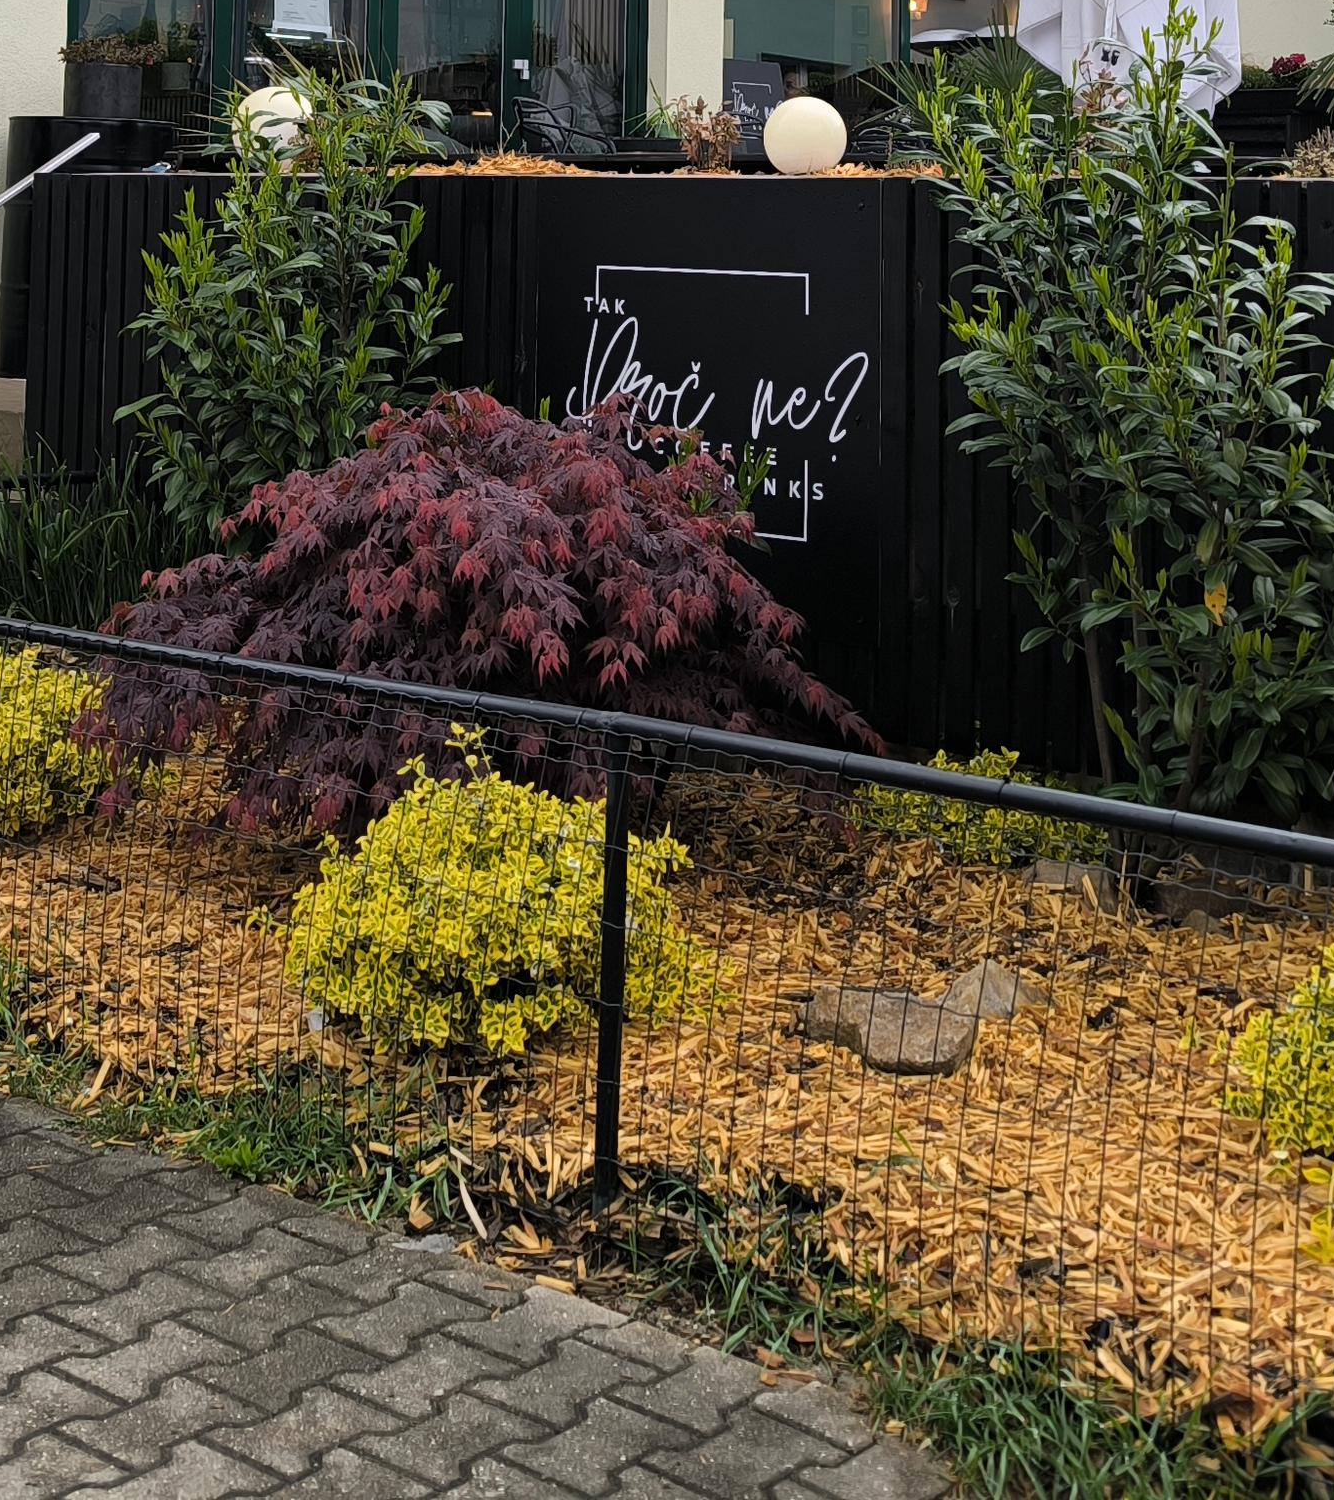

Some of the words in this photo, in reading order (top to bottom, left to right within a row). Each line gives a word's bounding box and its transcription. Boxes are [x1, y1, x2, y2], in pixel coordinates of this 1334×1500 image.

[583, 296, 627, 315] TAK
[751, 351, 870, 463] ne?
[721, 474, 824, 501] RINKS
